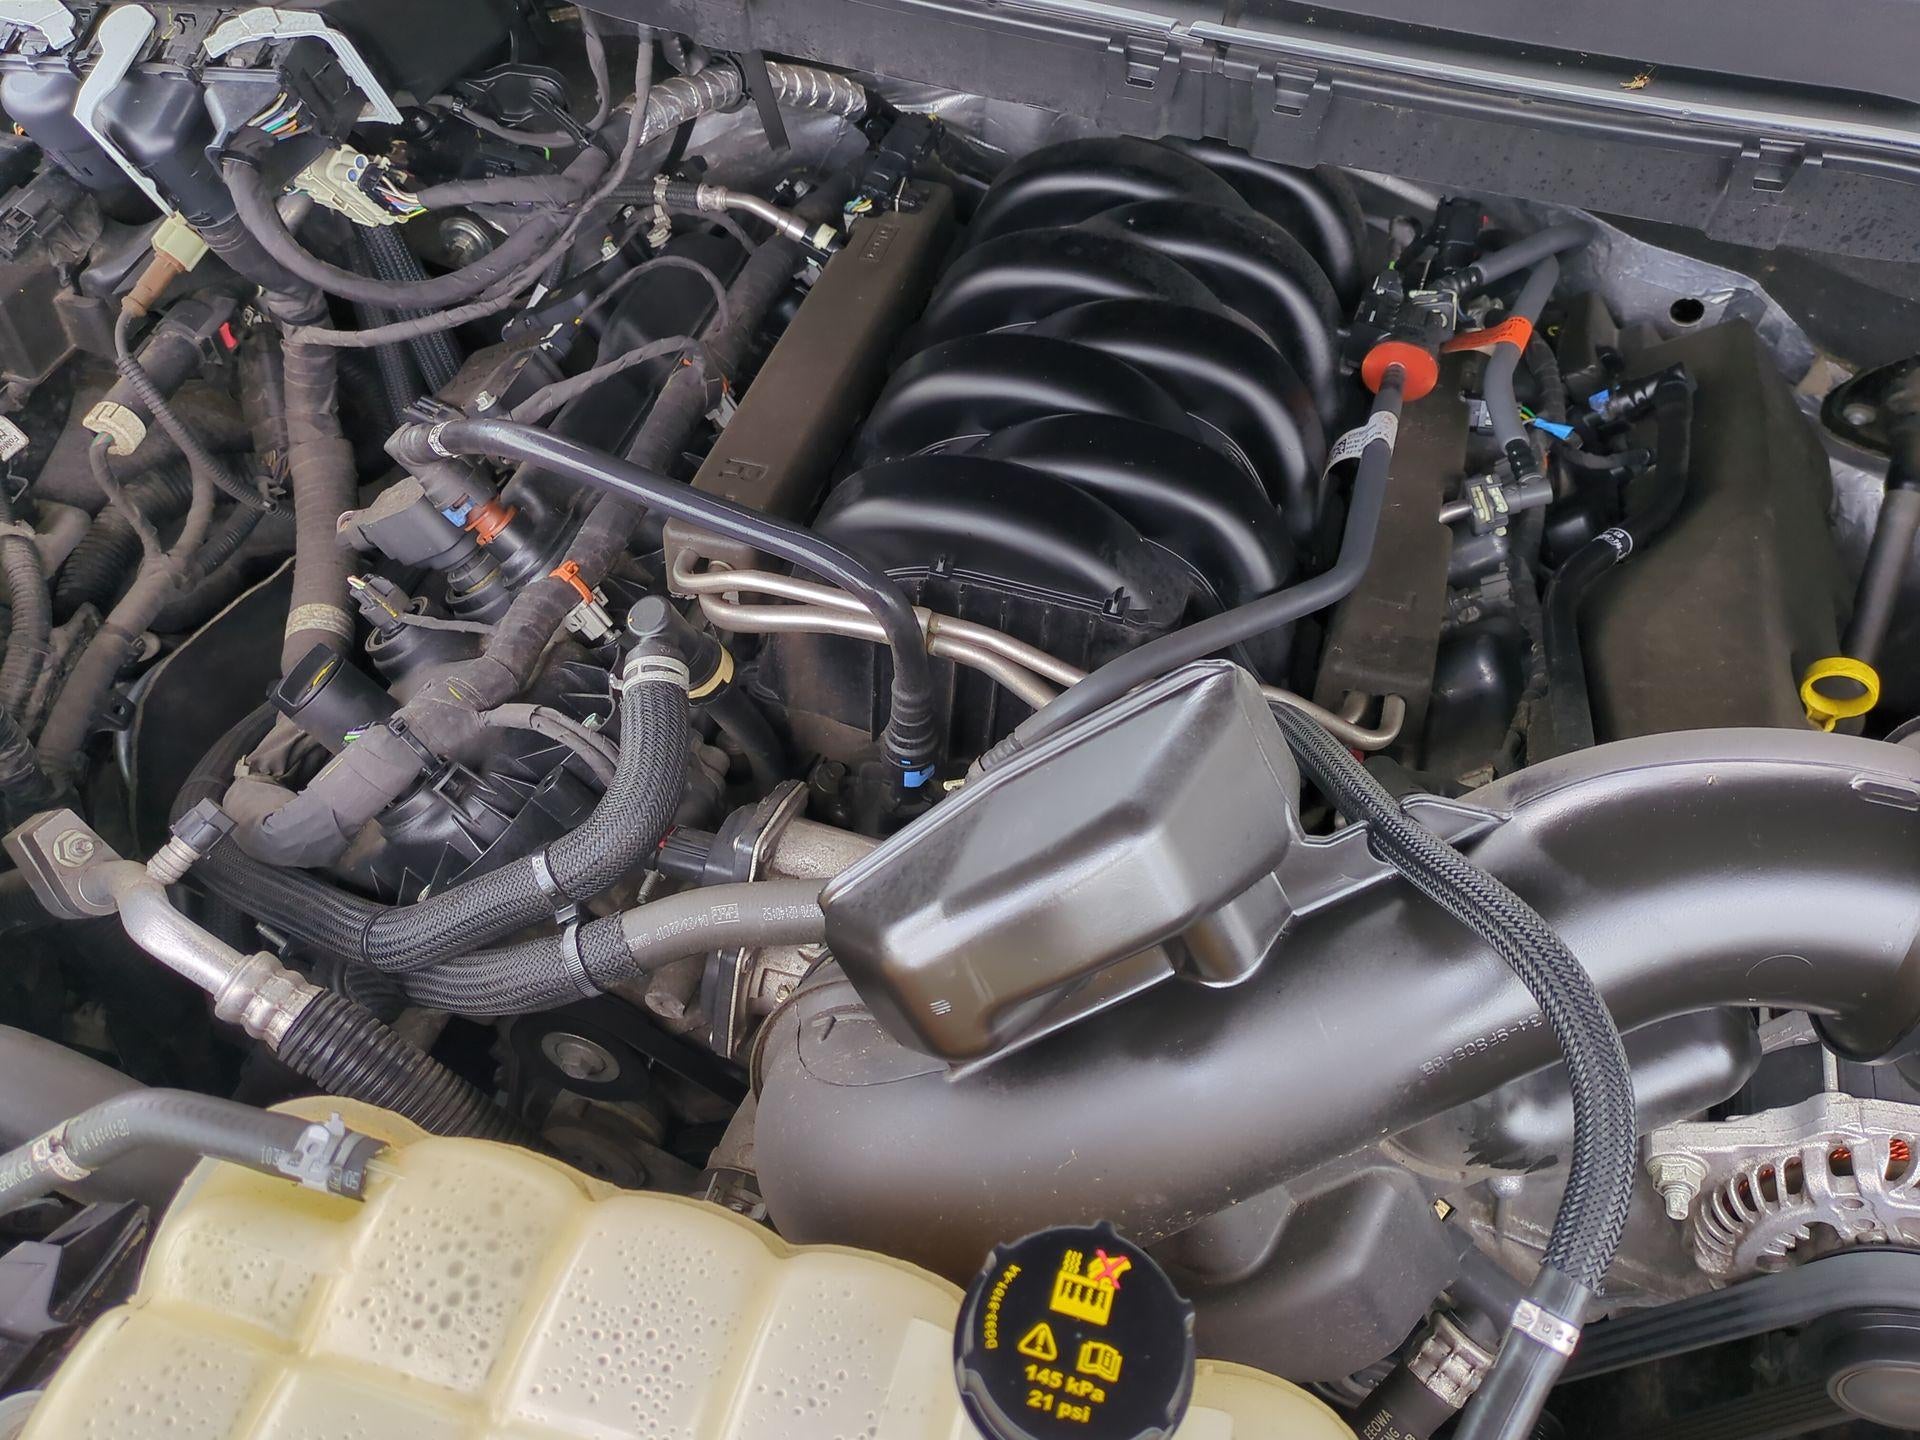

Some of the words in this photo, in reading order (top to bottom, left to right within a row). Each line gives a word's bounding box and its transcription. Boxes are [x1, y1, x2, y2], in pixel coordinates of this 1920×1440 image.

[1024, 1363, 1064, 1389] 145
[1064, 1375, 1106, 1403] kPa
[1026, 1389, 1055, 1411] 21
[1056, 1401, 1092, 1423] psi
